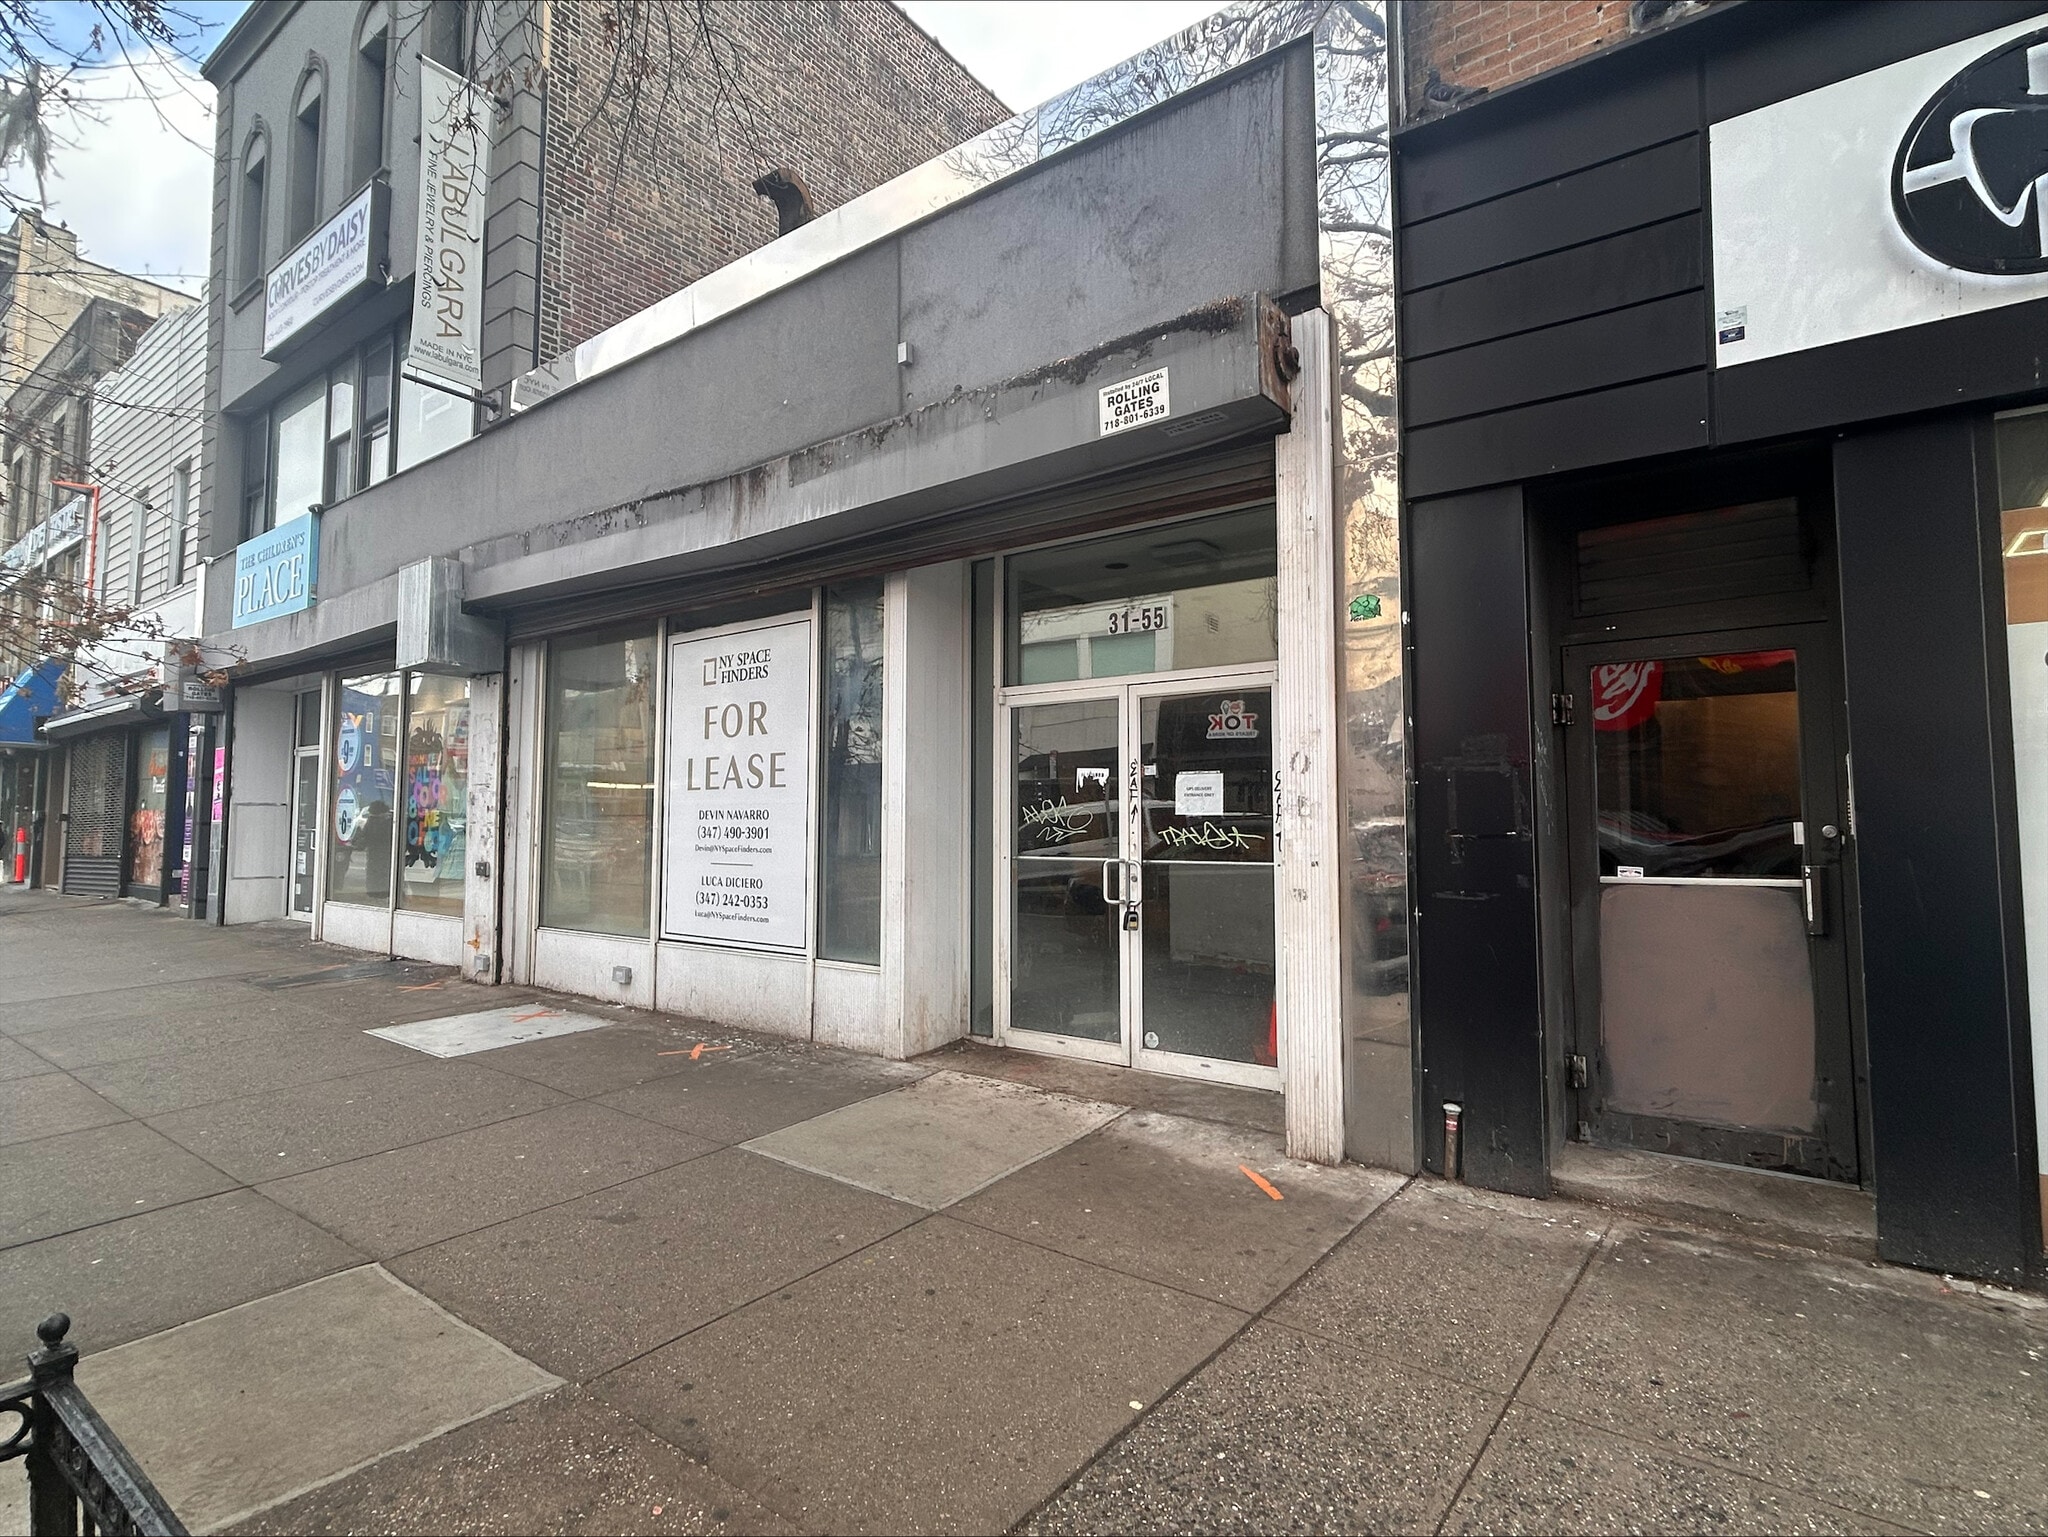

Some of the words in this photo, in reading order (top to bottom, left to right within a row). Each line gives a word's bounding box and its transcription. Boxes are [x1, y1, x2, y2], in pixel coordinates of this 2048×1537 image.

[426, 149, 438, 177] FINE
[424, 178, 437, 232] JEWELRY
[436, 140, 470, 338] LABULGARA
[421, 245, 434, 309] PIERCINGS
[413, 345, 479, 375] www.labulgara.com
[419, 338, 444, 354] MADE
[447, 349, 456, 357] IN
[456, 351, 473, 364] NYC
[1144, 372, 1164, 383] LOCAL
[1107, 381, 1160, 408] ROLLING
[1114, 396, 1154, 417] GATES
[1104, 404, 1165, 431] 718-801-6339
[241, 553, 256, 571] THE
[257, 531, 306, 564] CHILDREN'S
[237, 553, 304, 618] PLACE
[1108, 606, 1164, 634] 31-55
[719, 654, 735, 669] NY
[736, 648, 771, 667] SPACE
[720, 664, 769, 684] FINDERS
[704, 700, 768, 740] FOR
[687, 752, 786, 791] LEASE
[698, 809, 725, 820] DEVIN
[726, 809, 770, 820] NAVARRO
[697, 825, 722, 840] (347)
[723, 826, 769, 840] 490-3901
[694, 844, 773, 854] Devin@NYSpaceFinders.com
[701, 875, 723, 887] LUCA
[725, 877, 764, 889] DICIERO
[695, 890, 720, 907] (347)
[722, 893, 769, 910] 242-0353
[694, 909, 770, 923] Luca@NYSpaceFinders.com
